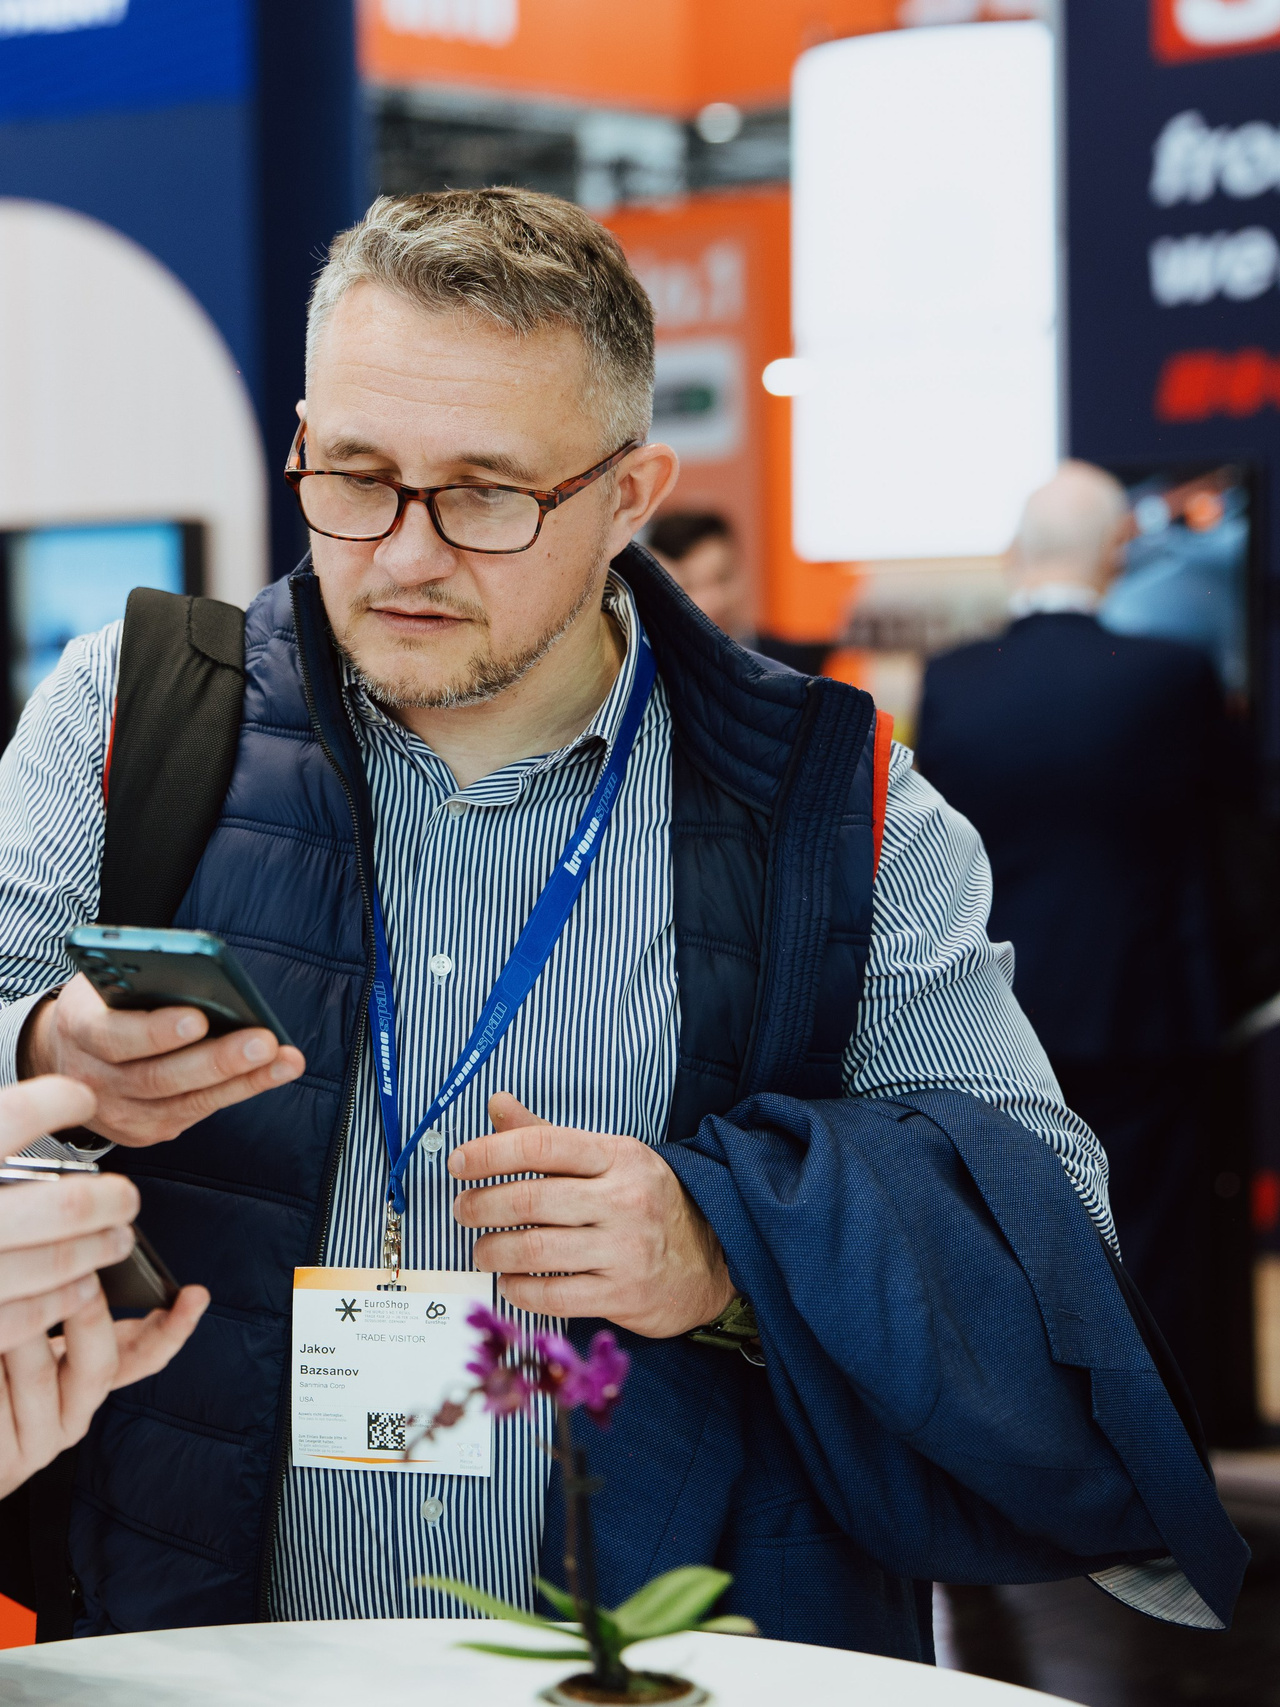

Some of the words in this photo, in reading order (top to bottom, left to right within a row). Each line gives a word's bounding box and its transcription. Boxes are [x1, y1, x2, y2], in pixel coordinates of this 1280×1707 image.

[1151, 109, 1280, 206] fro
[563, 772, 618, 877] kronospan
[373, 980, 393, 1096] kronospan
[437, 1001, 508, 1108] kronospan
[365, 1300, 409, 1310] EuroShop
[426, 1301, 446, 1319] 60
[356, 1333, 386, 1342] TRADE
[389, 1334, 426, 1343] VISITOR
[299, 1344, 336, 1354] Jakov
[300, 1365, 359, 1376] Bazsanov
[329, 1382, 345, 1390] Corp
